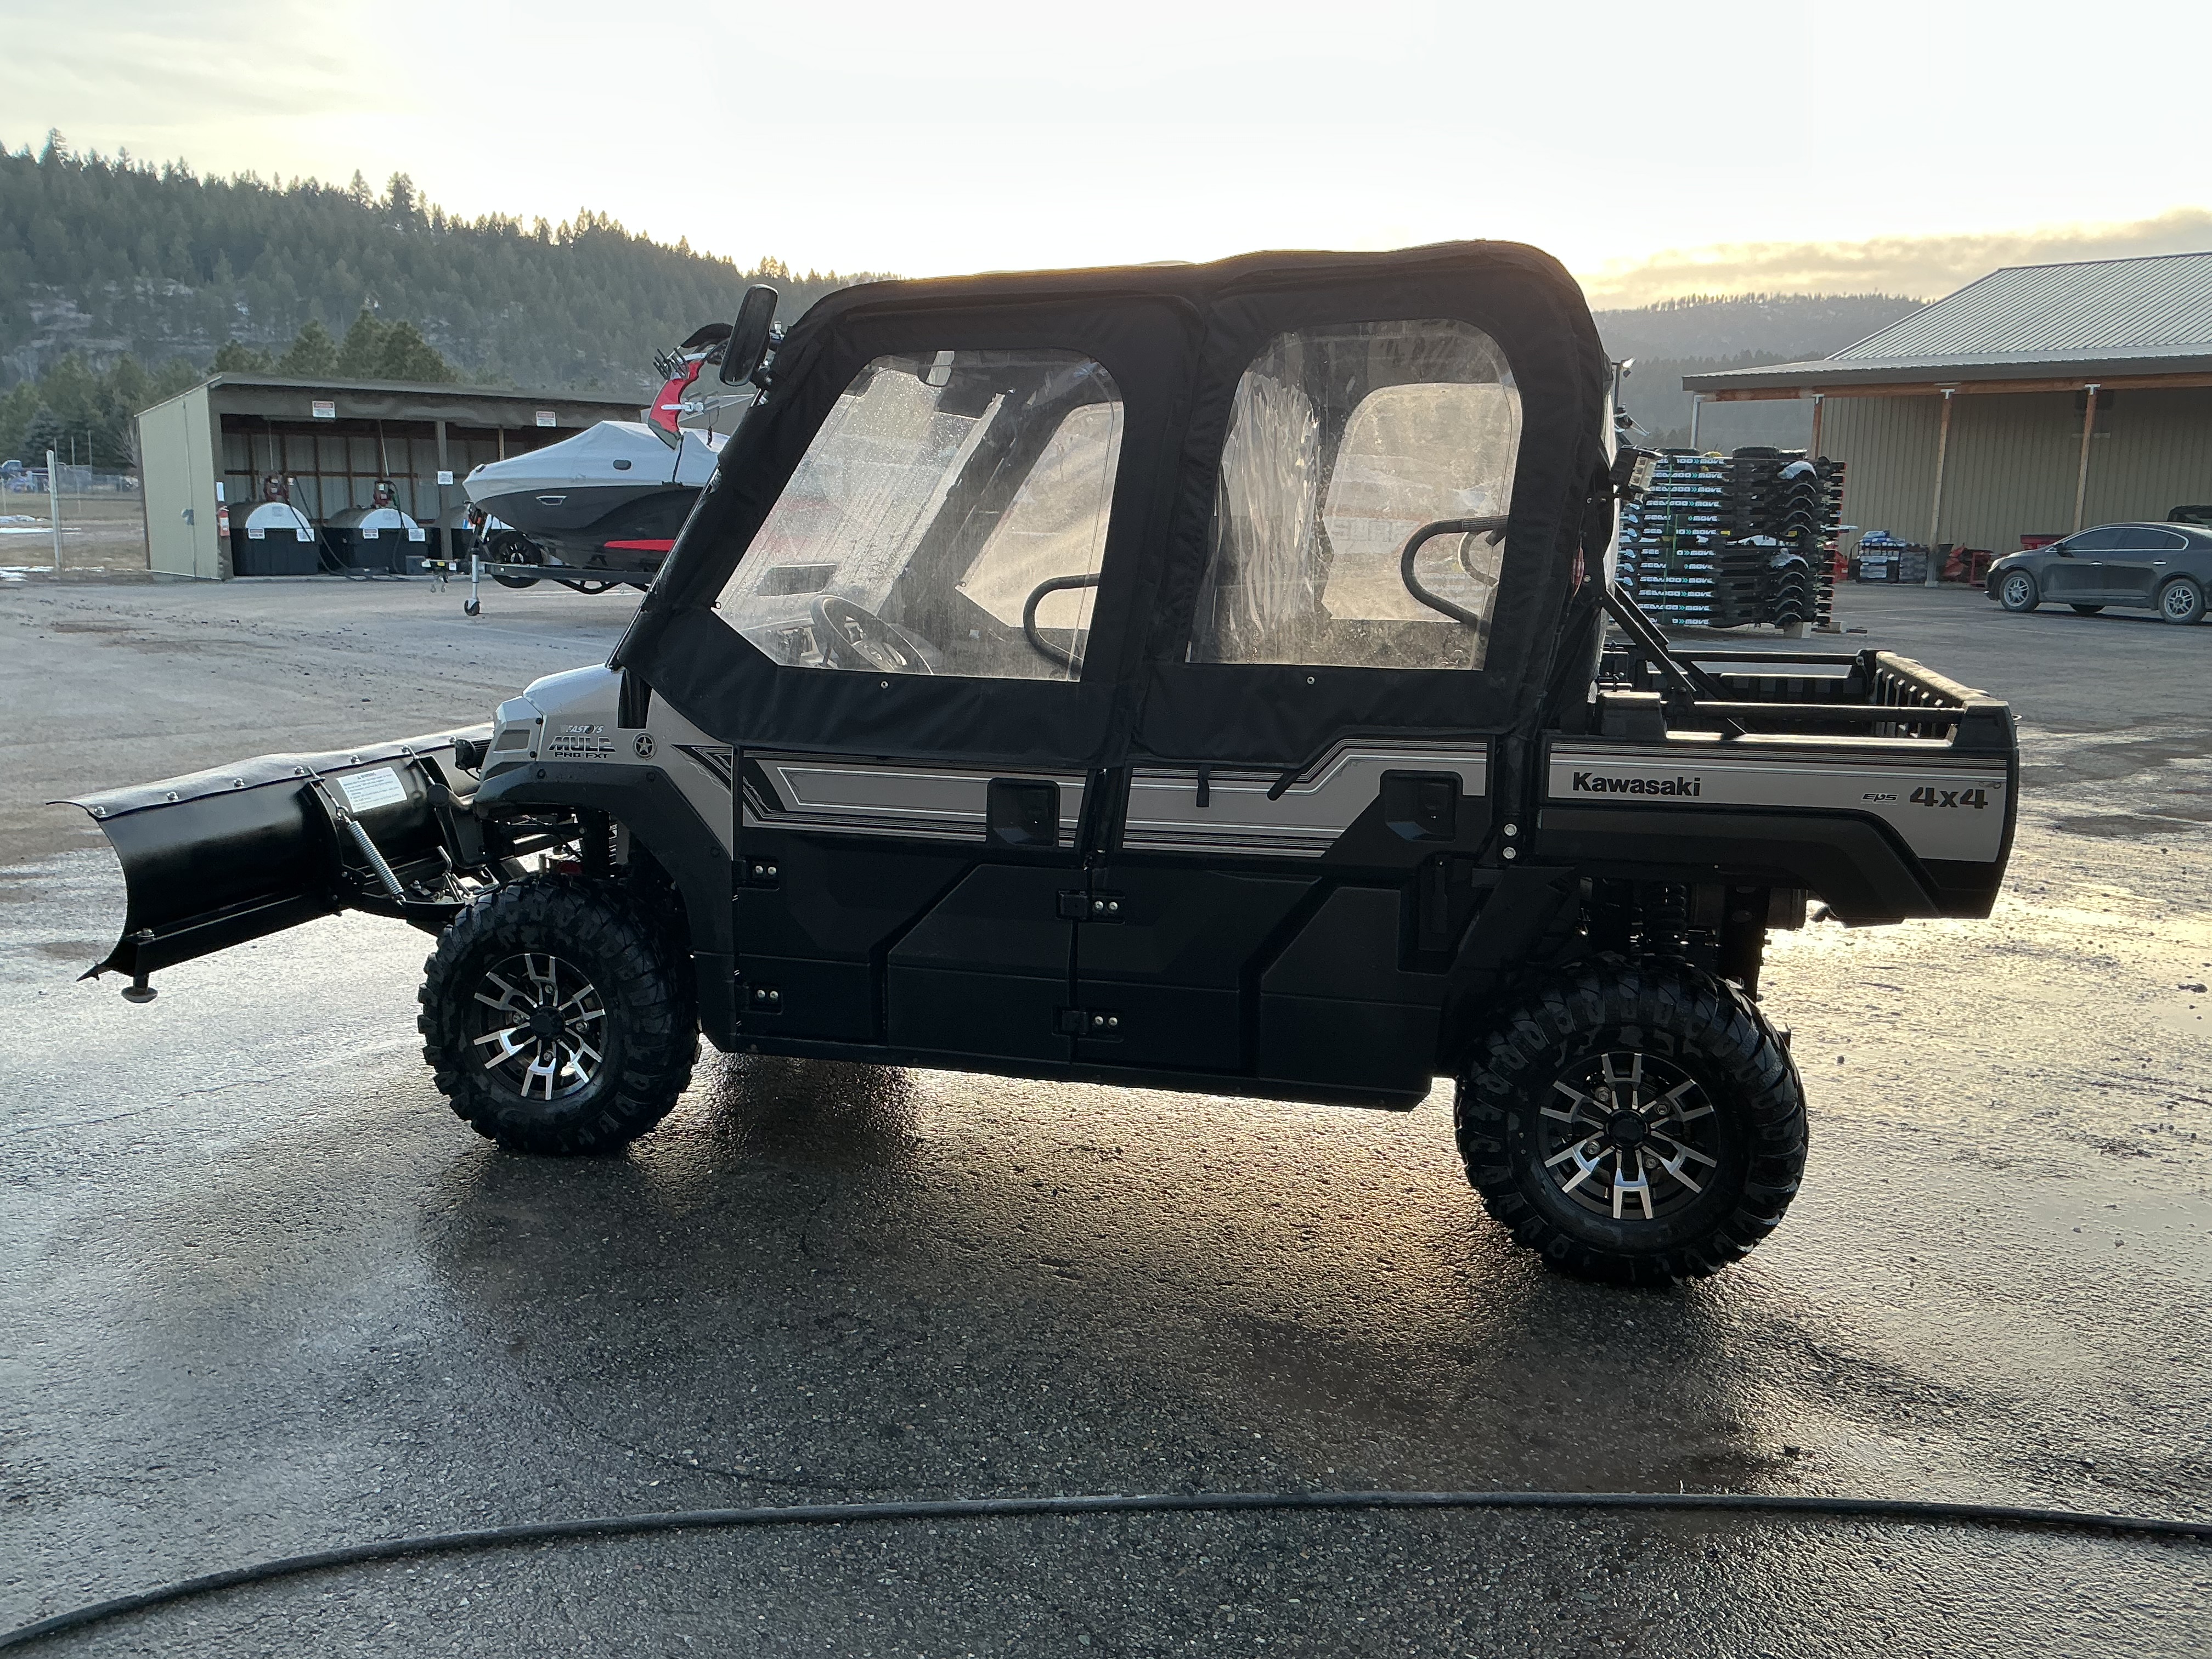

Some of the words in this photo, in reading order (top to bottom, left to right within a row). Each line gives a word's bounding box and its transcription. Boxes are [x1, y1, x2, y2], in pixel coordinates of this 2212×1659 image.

[548, 735, 616, 752] MULE
[1573, 771, 1701, 797] Kawasaki
[1909, 787, 1989, 809] 4x4
